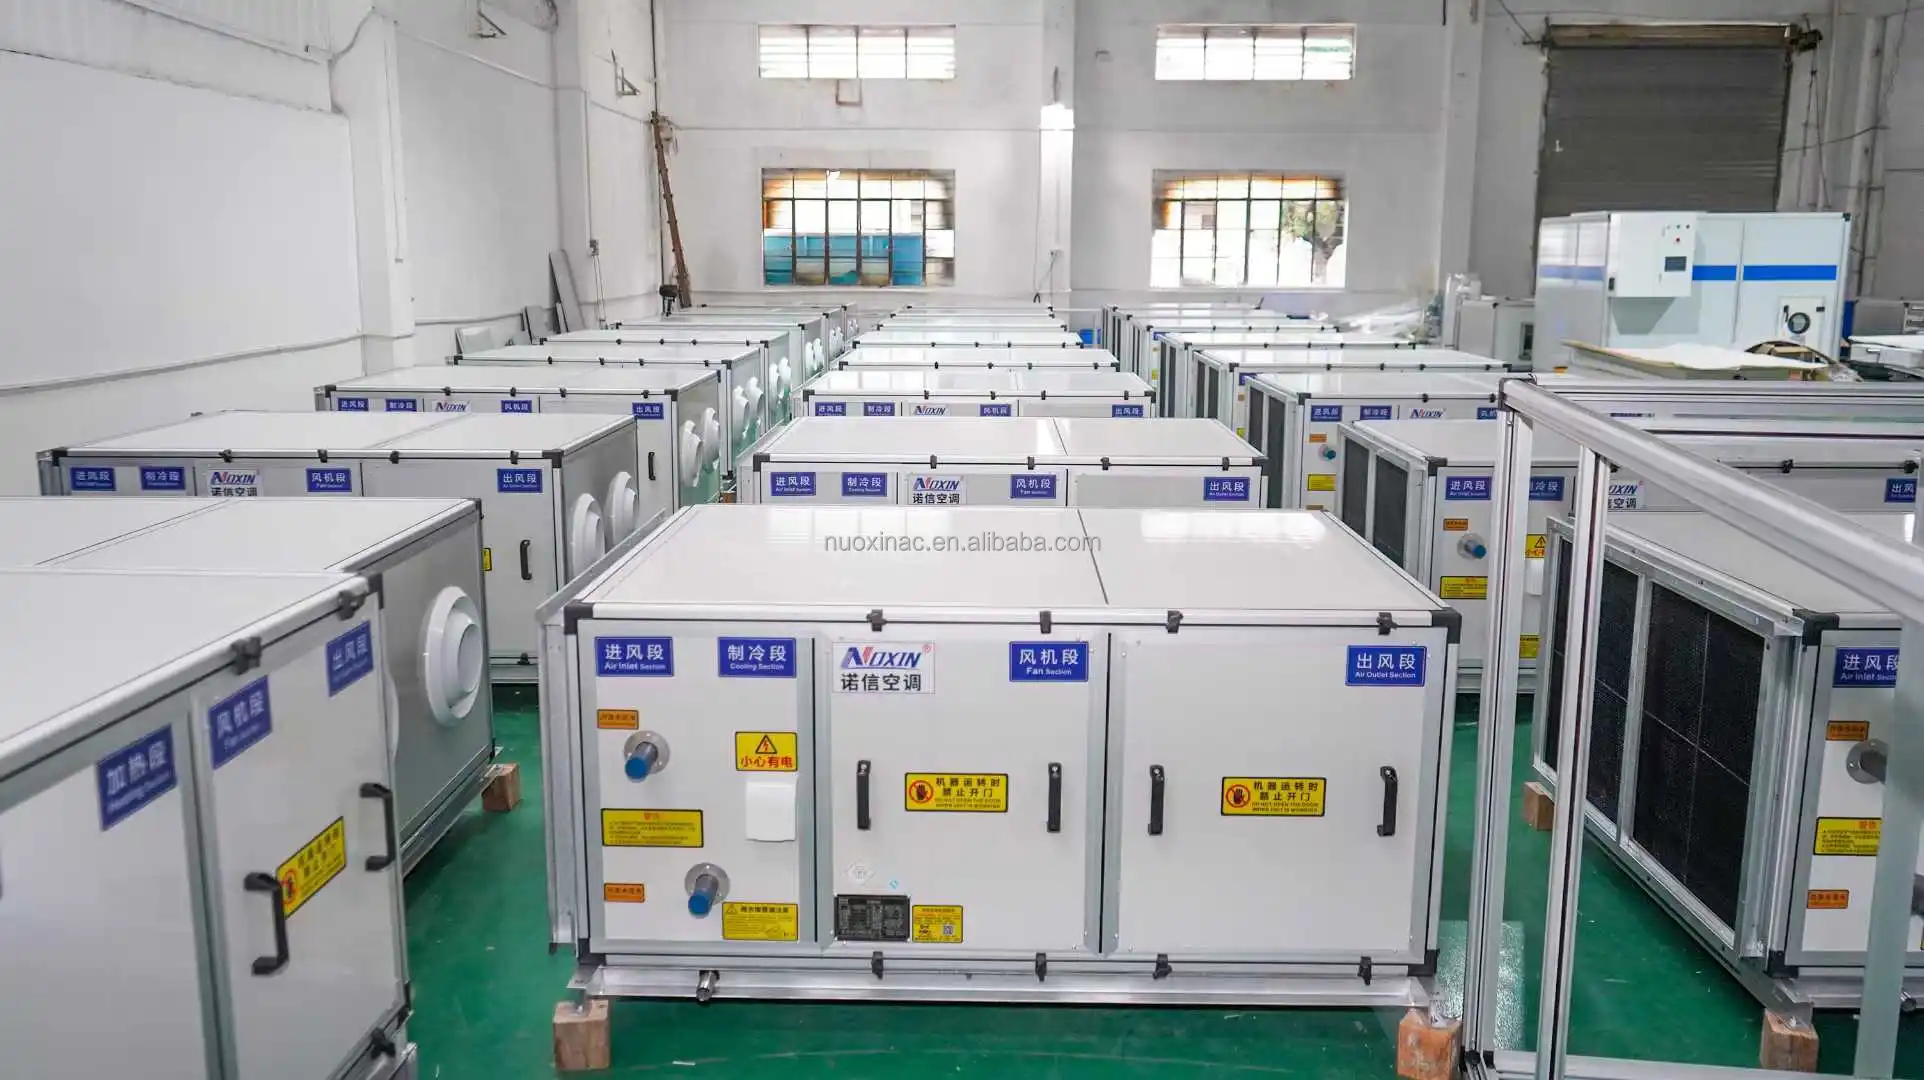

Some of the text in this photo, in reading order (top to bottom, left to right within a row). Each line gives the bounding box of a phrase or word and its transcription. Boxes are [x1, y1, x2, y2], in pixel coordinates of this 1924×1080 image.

[210, 471, 257, 486] NOXIN
[311, 472, 346, 483] 风机段
[502, 473, 538, 483] 出风段
[775, 476, 811, 487] 进风段
[847, 477, 882, 488] 制冷段
[912, 477, 962, 491] NOXIN
[1016, 478, 1051, 489] 风机段
[1209, 481, 1245, 492] 出风段
[1450, 480, 1486, 490] 进风段
[210, 487, 258, 497] 诺信空调
[912, 492, 960, 505] 诺信空调
[604, 644, 664, 661] 进风段
[728, 645, 787, 662] 制冷段
[840, 646, 922, 669] NOXIN
[1019, 648, 1080, 666] 风机段
[604, 662, 617, 671] Air
[618, 662, 639, 671] Inlet
[729, 662, 757, 671] Cooling
[1356, 652, 1417, 670] 出风段
[1026, 667, 1044, 676] Fan
[1355, 671, 1416, 679] Air Outlet Section
[1841, 672, 1854, 681] Air
[840, 673, 922, 692] 诺信空调
[740, 755, 793, 768] 小心有电
